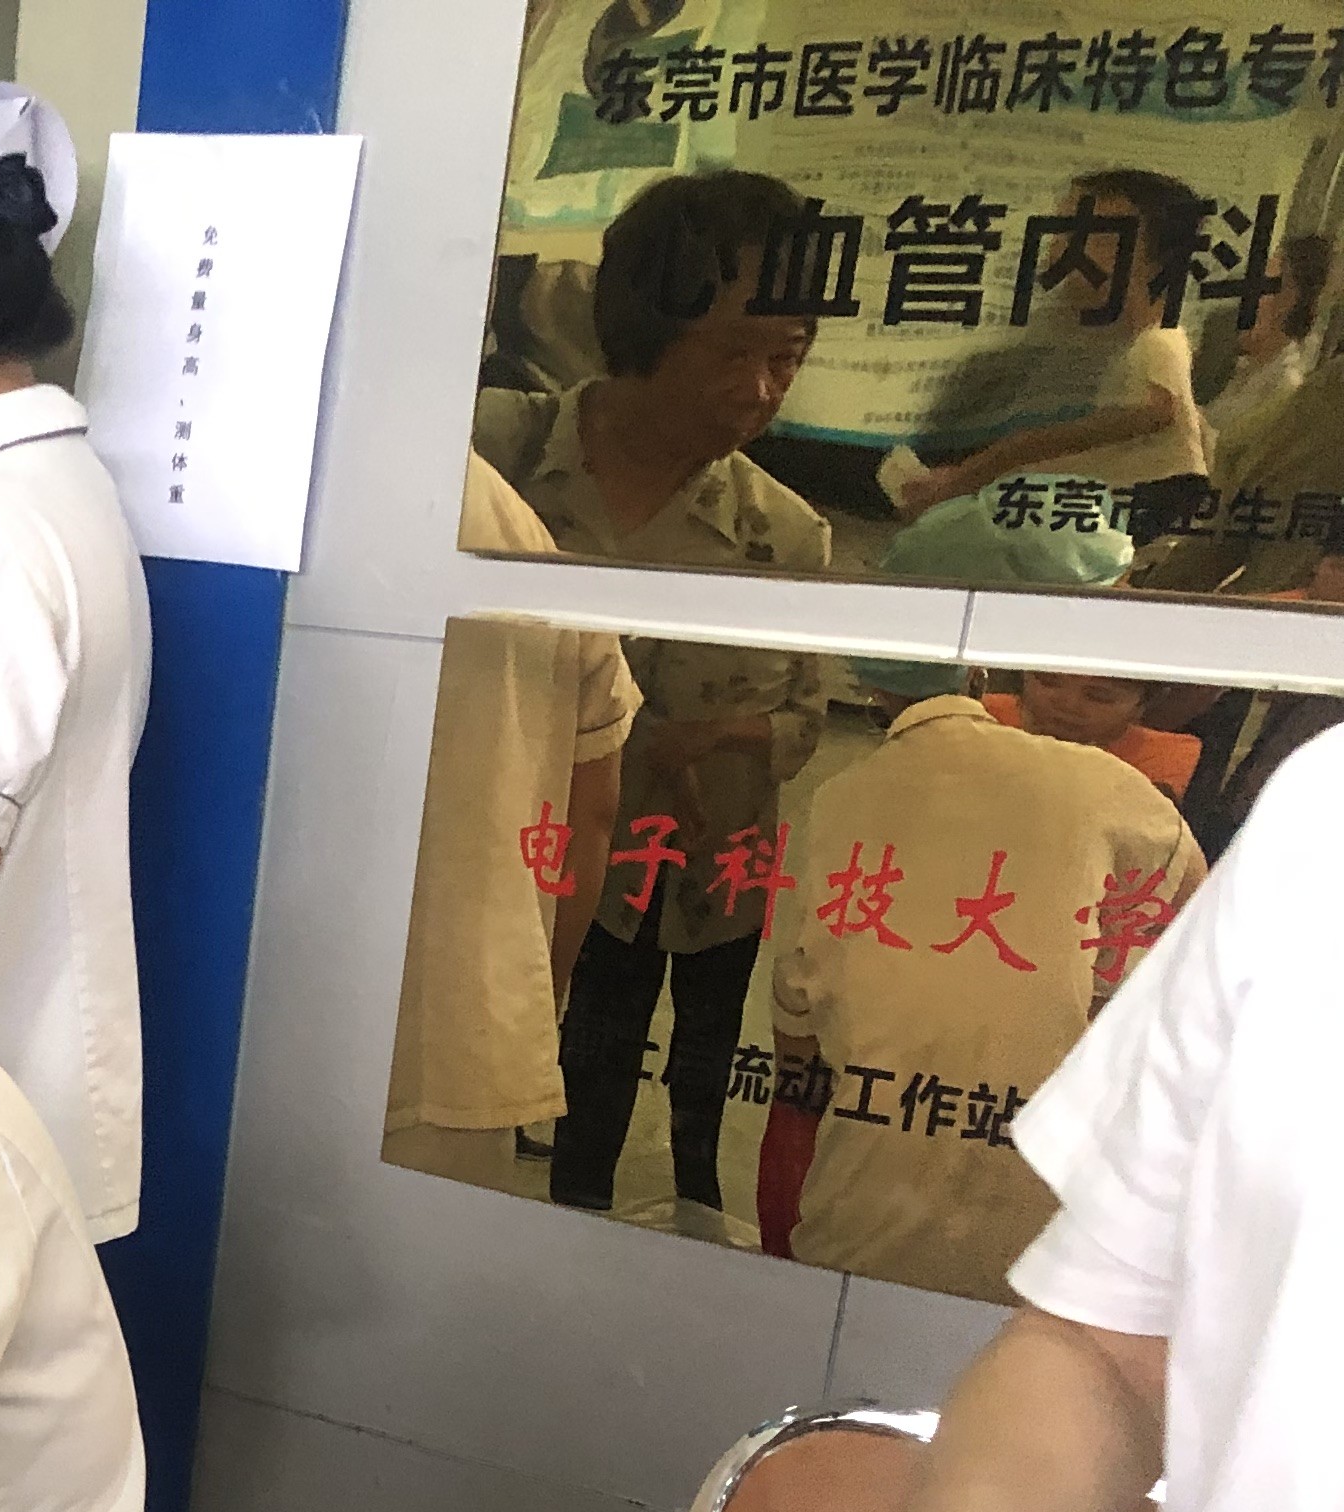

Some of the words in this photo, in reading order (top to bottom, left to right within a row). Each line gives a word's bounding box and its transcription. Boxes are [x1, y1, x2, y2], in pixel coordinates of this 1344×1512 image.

[167, 224, 219, 504] 免费量身高、测体重
[517, 801, 1178, 981] 电子科技大学
